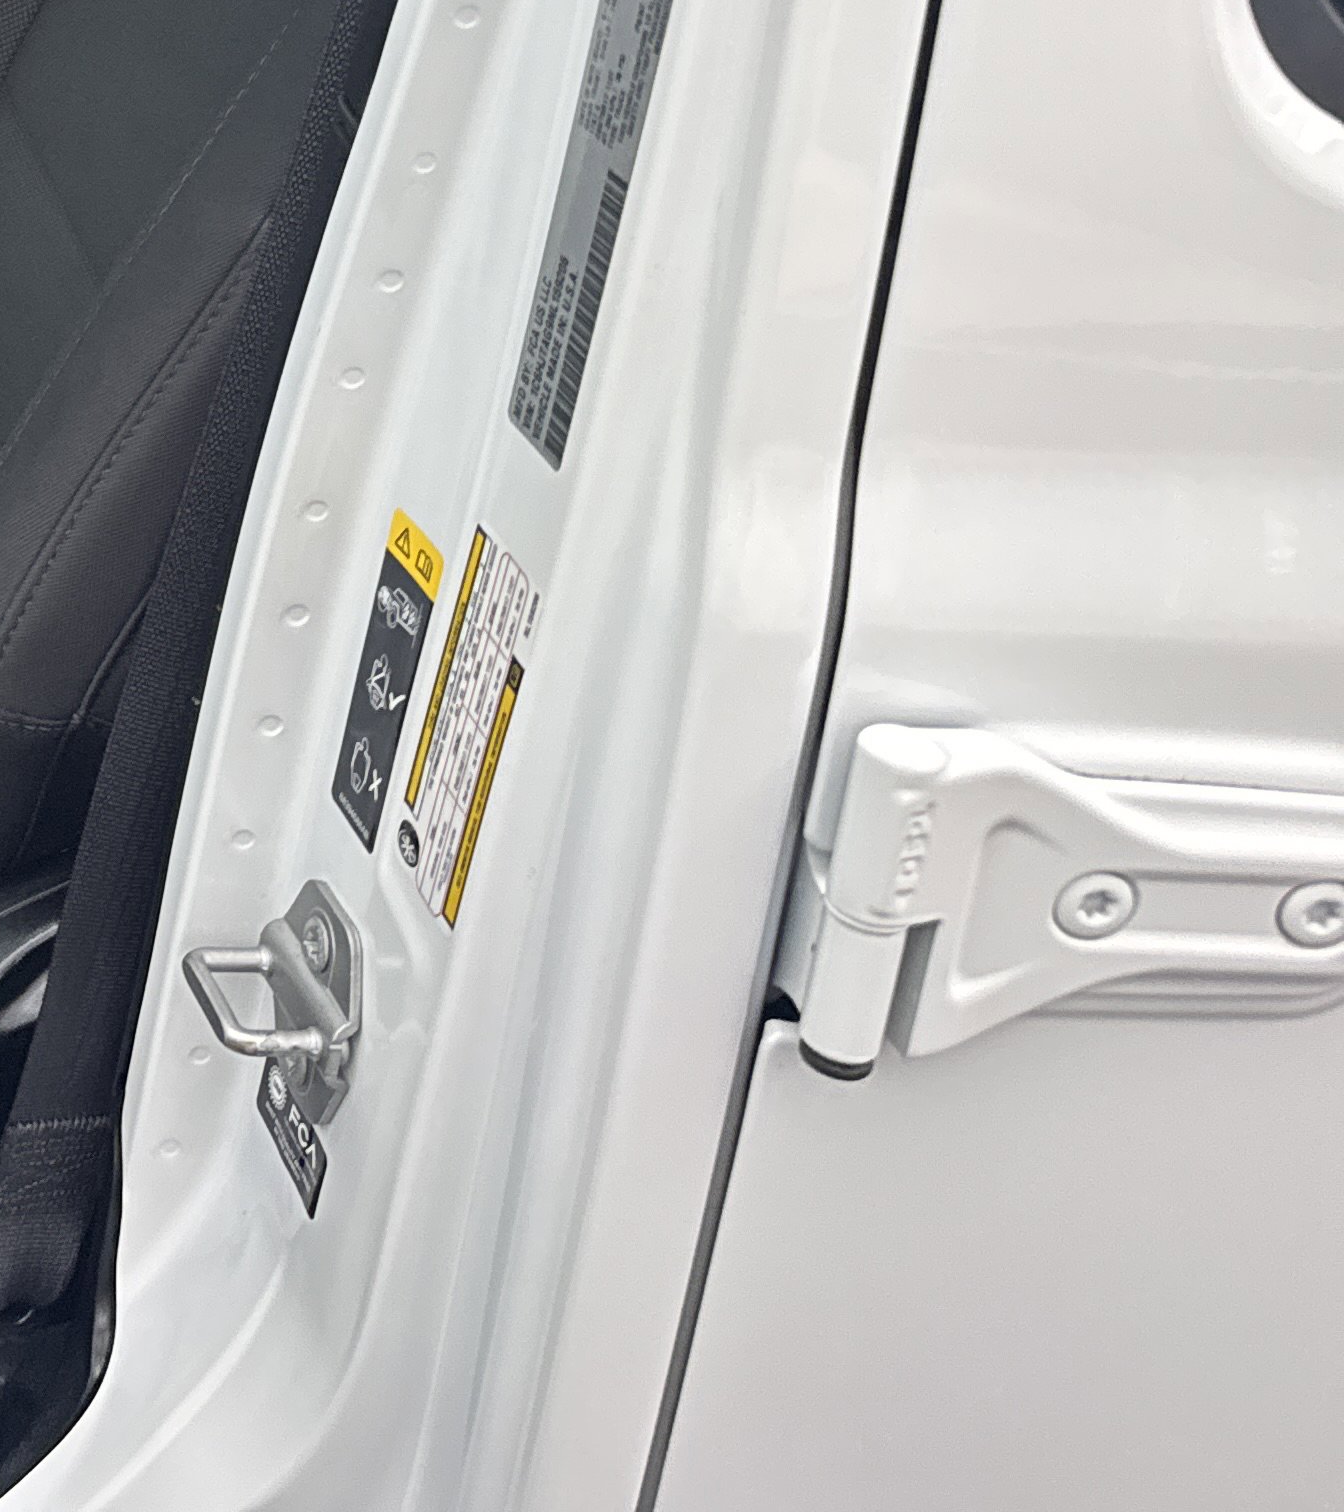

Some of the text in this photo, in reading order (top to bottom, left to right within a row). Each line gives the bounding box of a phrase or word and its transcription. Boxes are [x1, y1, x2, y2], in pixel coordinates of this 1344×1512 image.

[539, 274, 552, 303] LLC
[534, 303, 545, 327] US
[527, 328, 540, 358] FCA
[532, 381, 552, 440] VEHICLE
[546, 337, 563, 382] MADE
[288, 1103, 317, 1169] FCA
